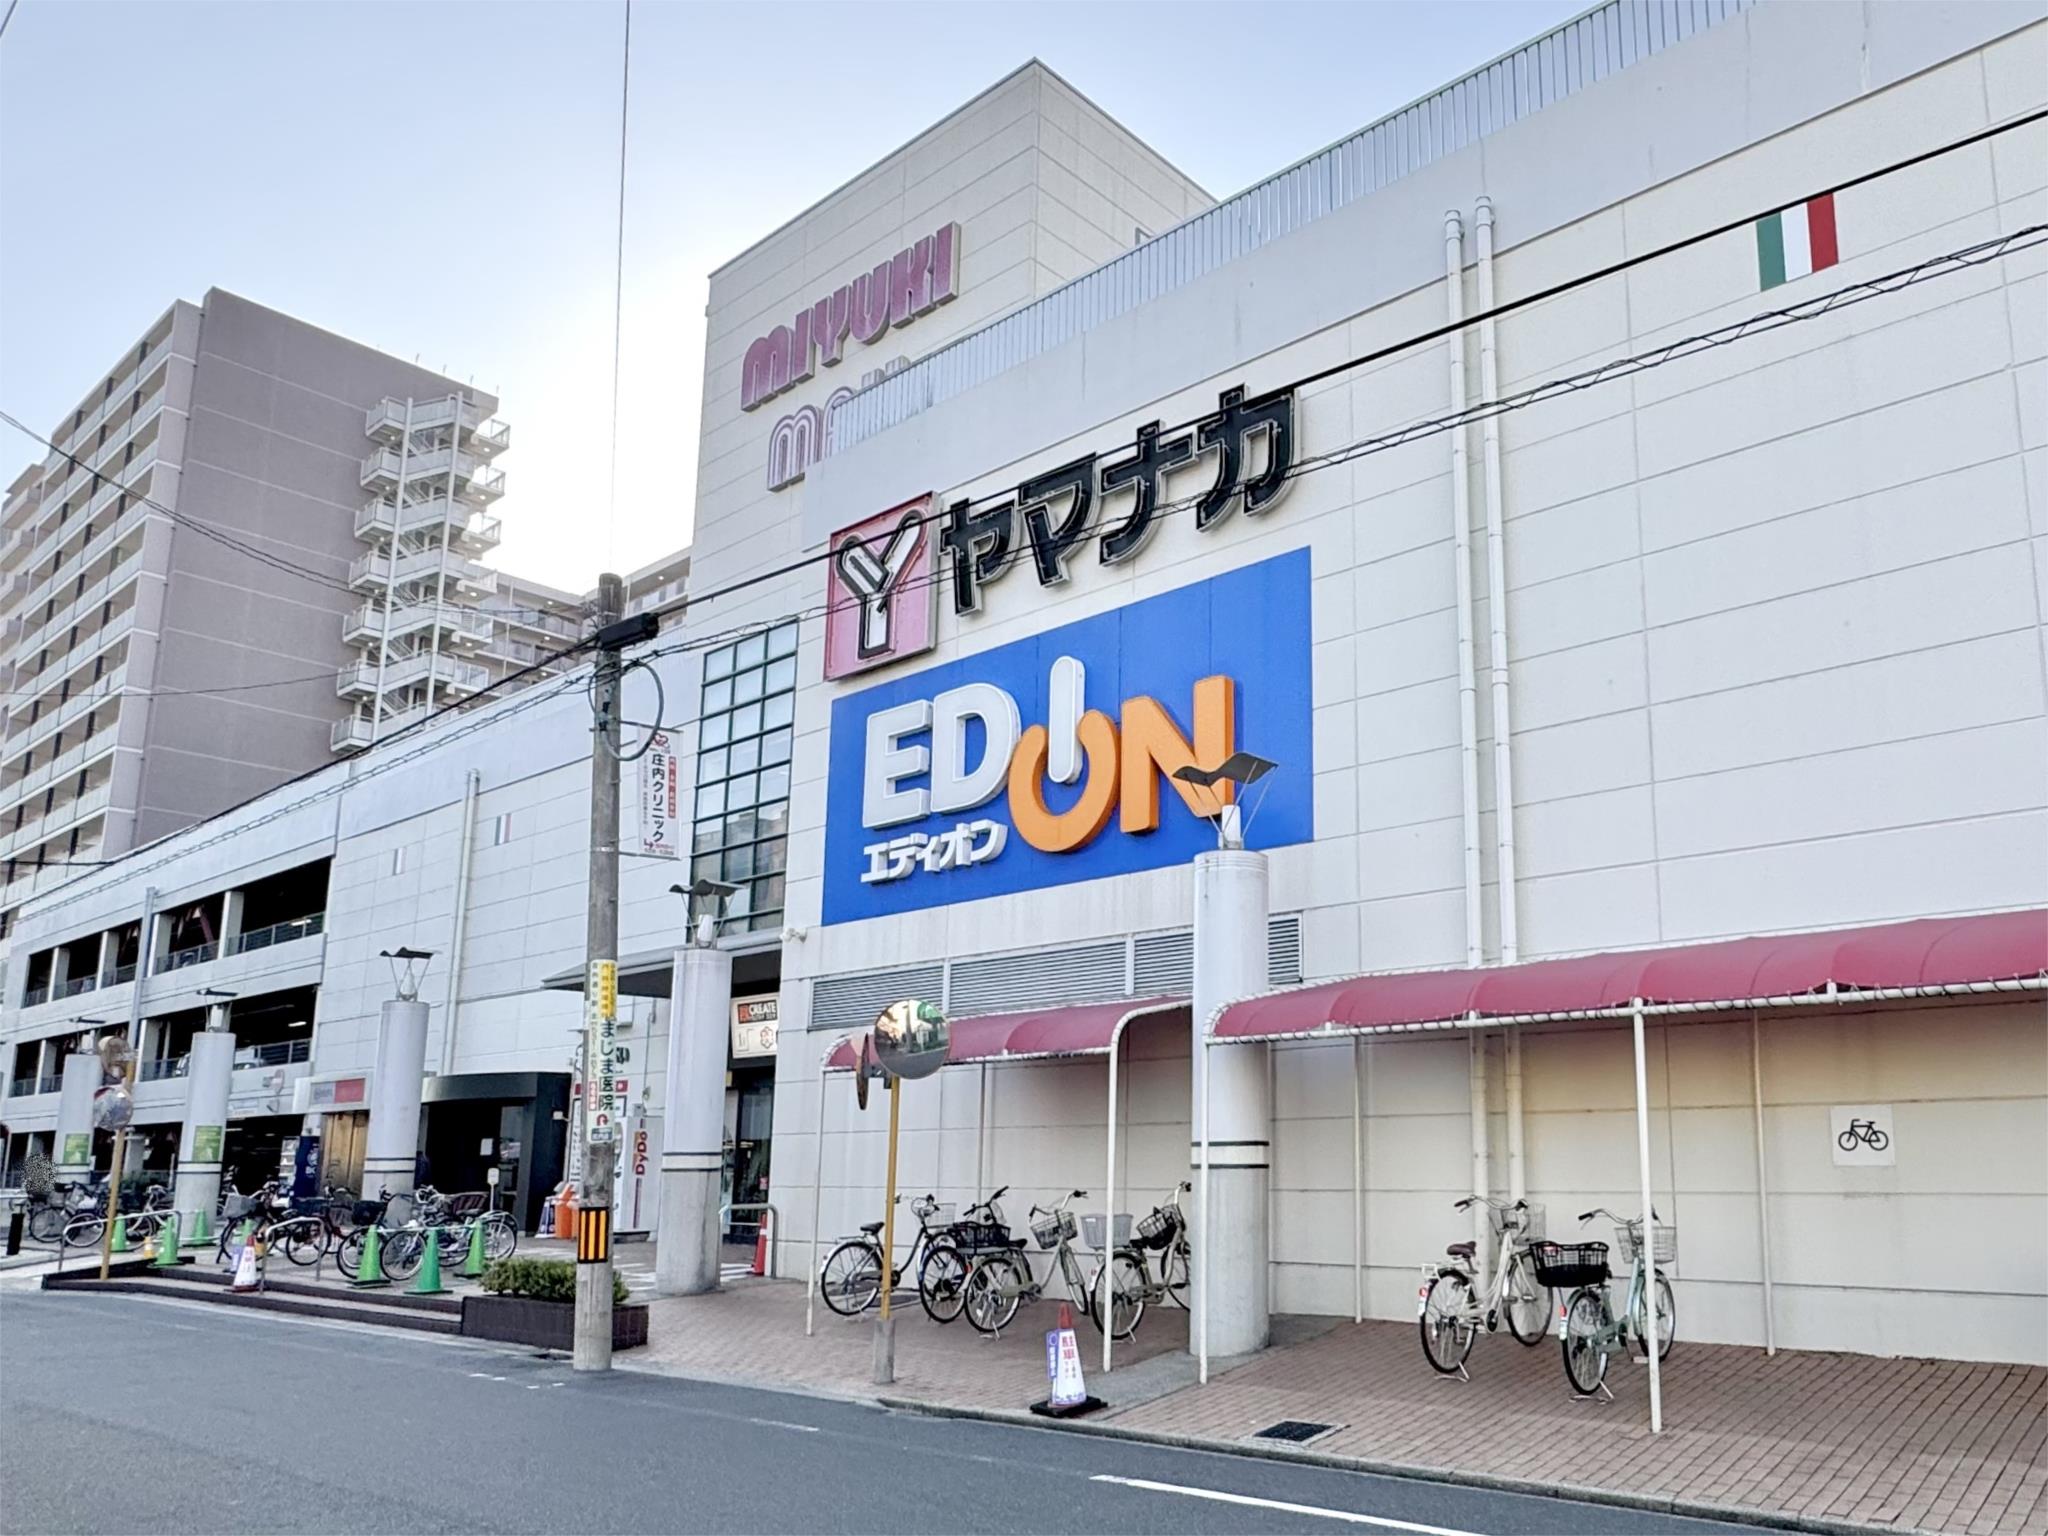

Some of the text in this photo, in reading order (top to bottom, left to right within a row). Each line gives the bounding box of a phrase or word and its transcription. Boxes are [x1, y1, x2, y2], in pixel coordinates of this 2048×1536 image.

[741, 221, 961, 412] MIYUKI
[939, 384, 1301, 616] ヤマナカ
[651, 753, 666, 843] 庄内クリニック
[862, 656, 1235, 853] EDION
[860, 818, 1009, 884] エディオン
[599, 1020, 616, 1111] まじま医院
[635, 1130, 649, 1176] DyDo
